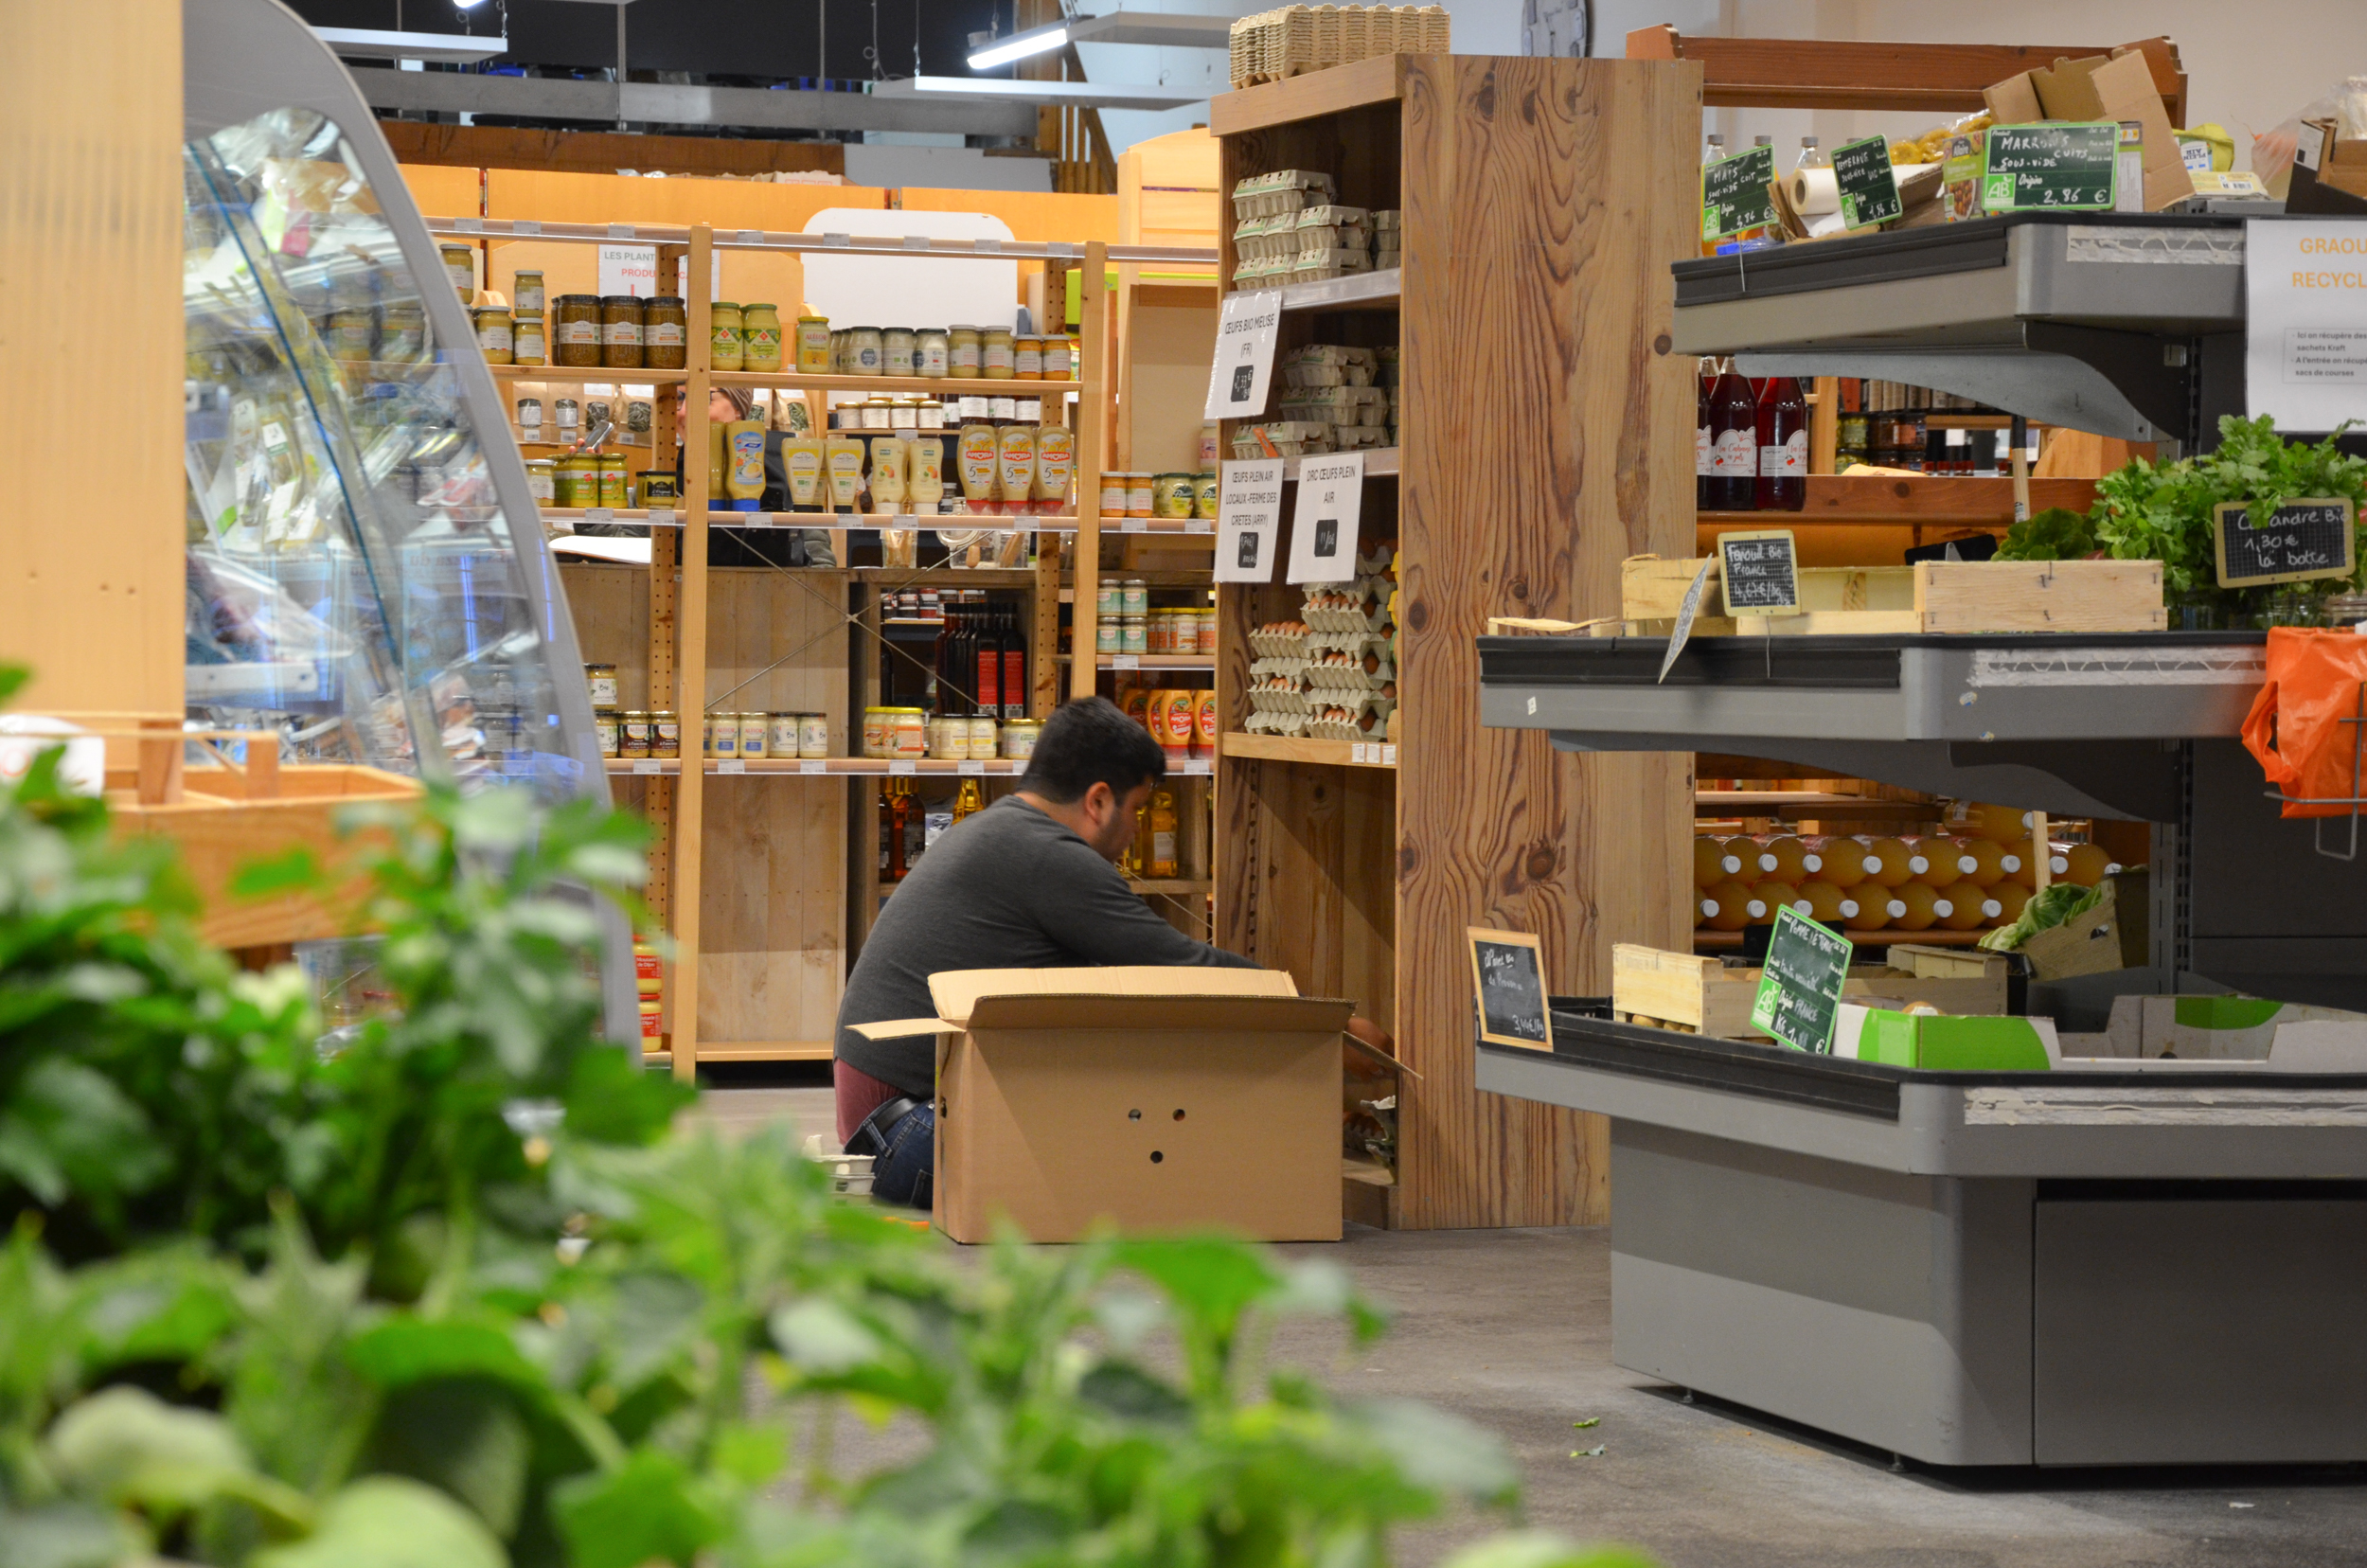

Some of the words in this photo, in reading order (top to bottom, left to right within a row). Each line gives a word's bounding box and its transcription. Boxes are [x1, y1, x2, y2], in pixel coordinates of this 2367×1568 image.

[1987, 182, 2010, 198] AB
[2094, 189, 2107, 203] €
[604, 251, 622, 259] LES
[625, 252, 655, 261] PLANT
[621, 268, 656, 278] PRODU
[1243, 317, 1254, 331] BIO
[1254, 313, 1274, 330] MEUSE
[2319, 331, 2352, 340] récupère
[1240, 342, 1253, 358] (FR)
[1004, 452, 1031, 461] AMORA
[1041, 452, 1069, 461] AMORA
[1249, 471, 1264, 482] PLEIN
[1264, 471, 1273, 481] AIR
[1307, 469, 1319, 482] DRC
[1338, 465, 1356, 479] PLEIN
[1225, 492, 1247, 505] LOCAUX
[1267, 491, 1276, 503] DES
[1324, 491, 1335, 504] AIR
[1252, 514, 1269, 527] (ARRY)
[2237, 510, 2320, 530] Candre
[2324, 508, 2349, 522] Bio
[2258, 553, 2275, 567] la
[2287, 550, 2329, 565] botte
[1757, 989, 1775, 1013] AB
[1815, 1039, 1825, 1055] €
